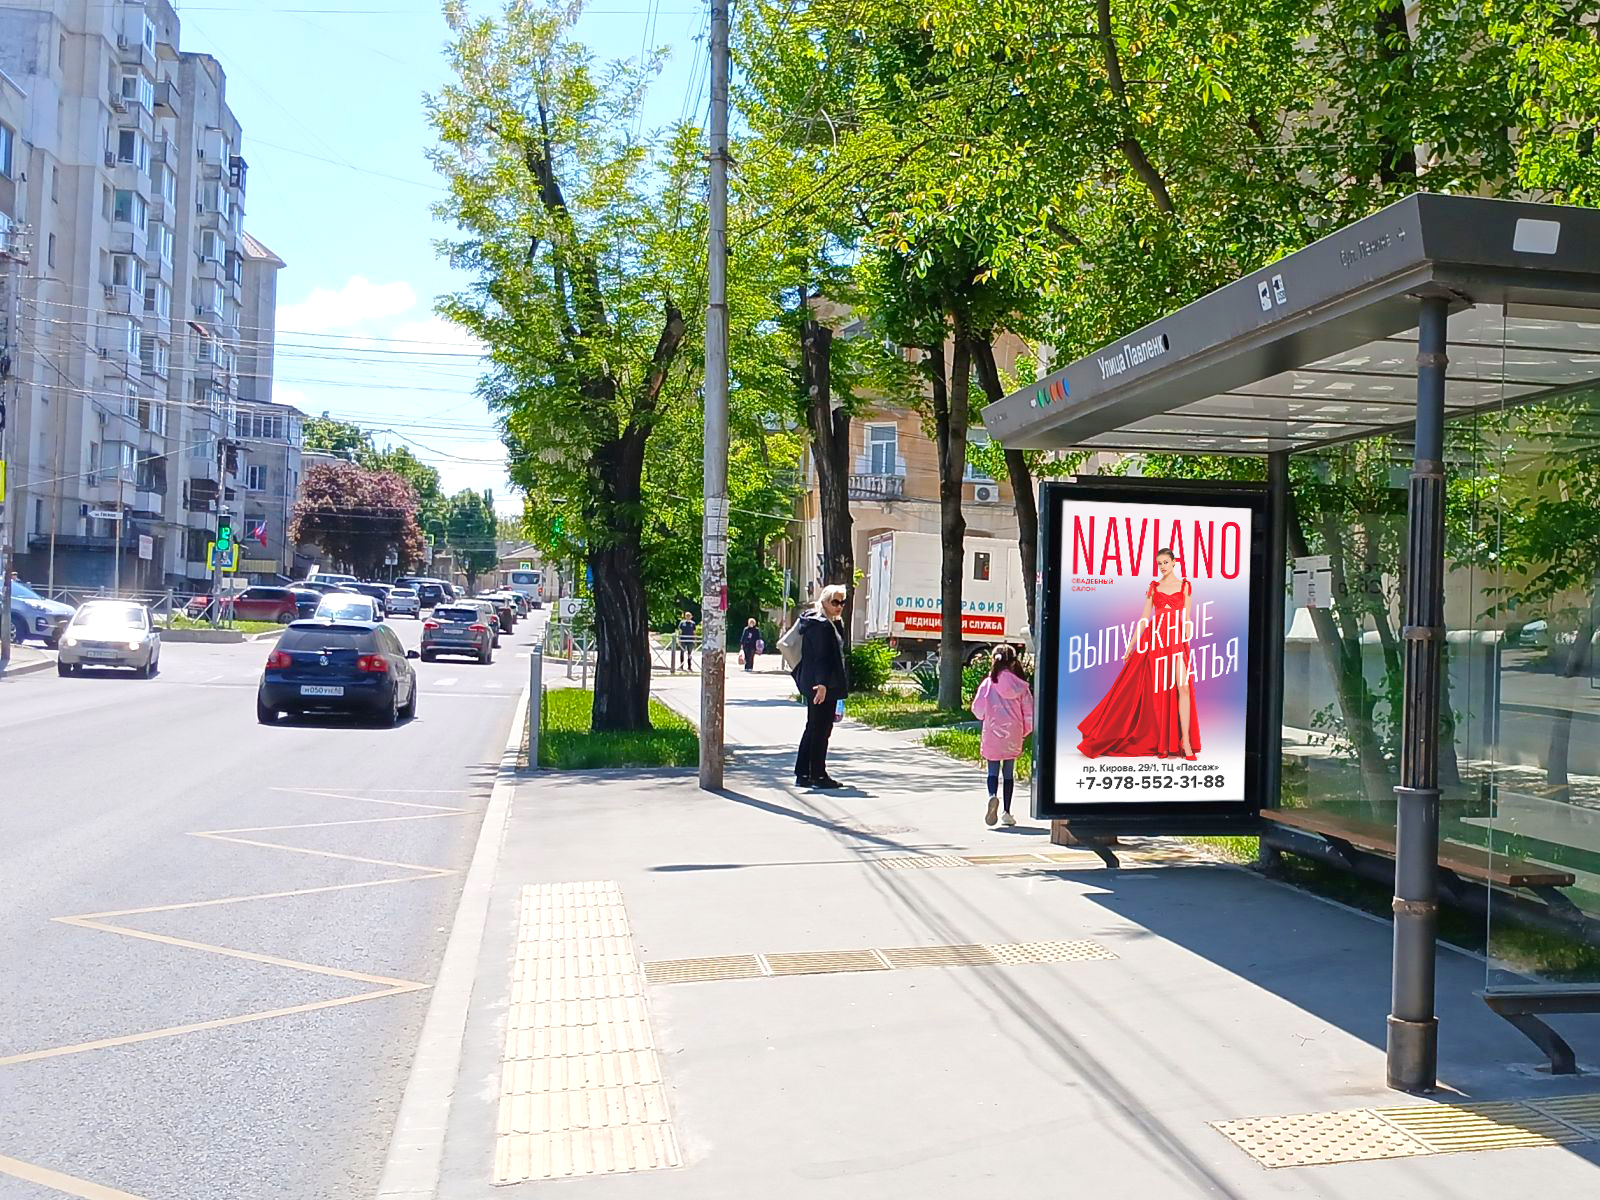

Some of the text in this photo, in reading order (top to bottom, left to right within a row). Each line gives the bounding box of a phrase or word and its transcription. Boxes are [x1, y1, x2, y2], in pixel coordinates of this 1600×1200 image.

[1097, 352, 1126, 380] Улица
[1072, 515, 1241, 579] NAVIANO
[1071, 577, 1114, 585] СВАДЕБНЫЙ
[895, 597, 1003, 613] ФЛЮОРРАФИЯ
[905, 617, 1003, 630] МЕДИЦИЯ СЛУЖБА
[1068, 600, 1214, 674] ВЫПУСКНЫЕ
[1154, 636, 1239, 694] ПЛАТЬЯ
[1099, 764, 1136, 773] Кирова,
[1138, 763, 1159, 772] 29/1,
[1161, 764, 1174, 772] ТЦ
[1176, 763, 1220, 772] «Пассаж»
[1076, 775, 1225, 790] +7-978-552-31-88
